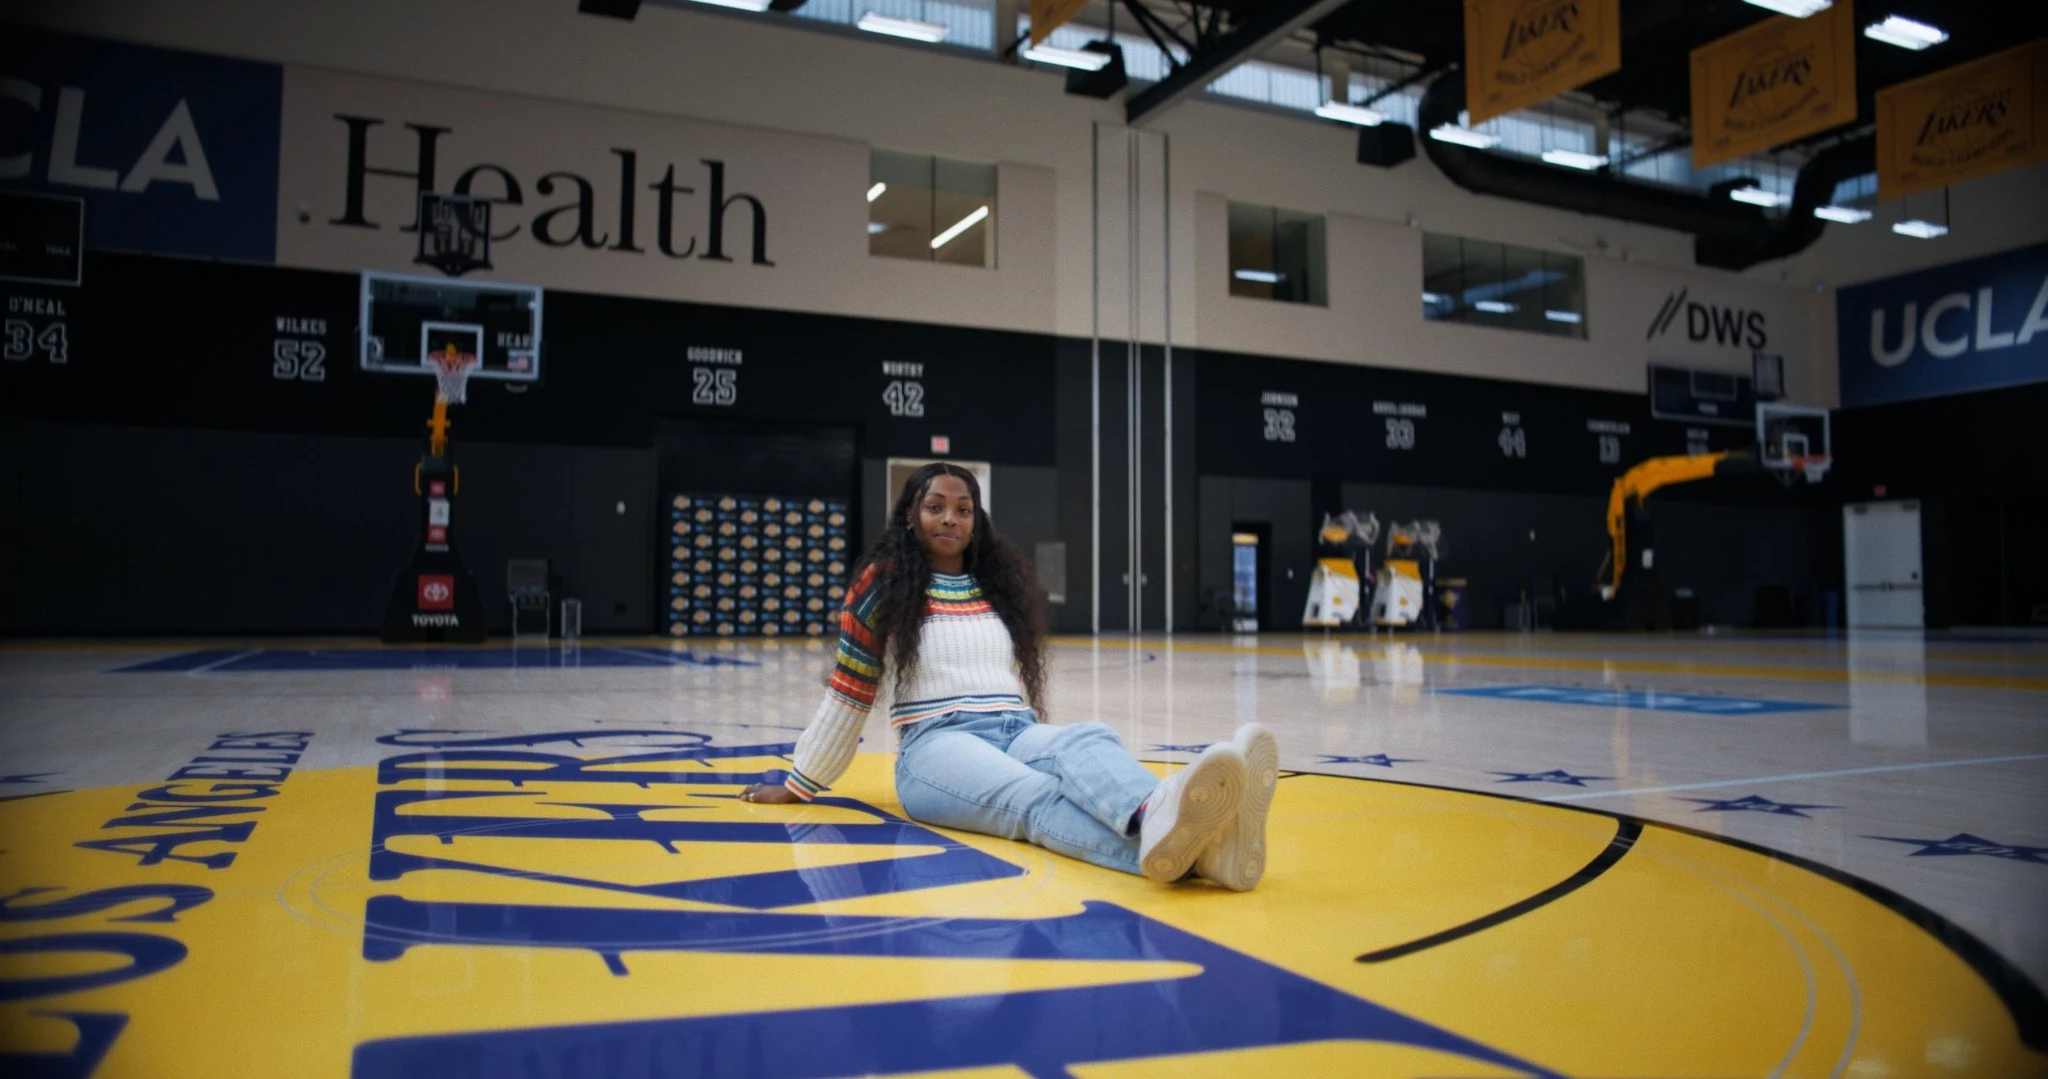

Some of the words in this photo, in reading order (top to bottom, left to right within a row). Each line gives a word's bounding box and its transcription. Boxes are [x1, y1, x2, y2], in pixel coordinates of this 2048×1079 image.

[328, 112, 776, 268] Health
[8, 295, 68, 317] O'NEAL
[275, 315, 328, 337] WILKES
[3, 317, 69, 365] 34
[272, 338, 327, 383] 52
[692, 365, 737, 407] 25
[881, 379, 925, 418] 42
[411, 612, 460, 628] TOYOTA
[72, 730, 316, 870] ANGELES
